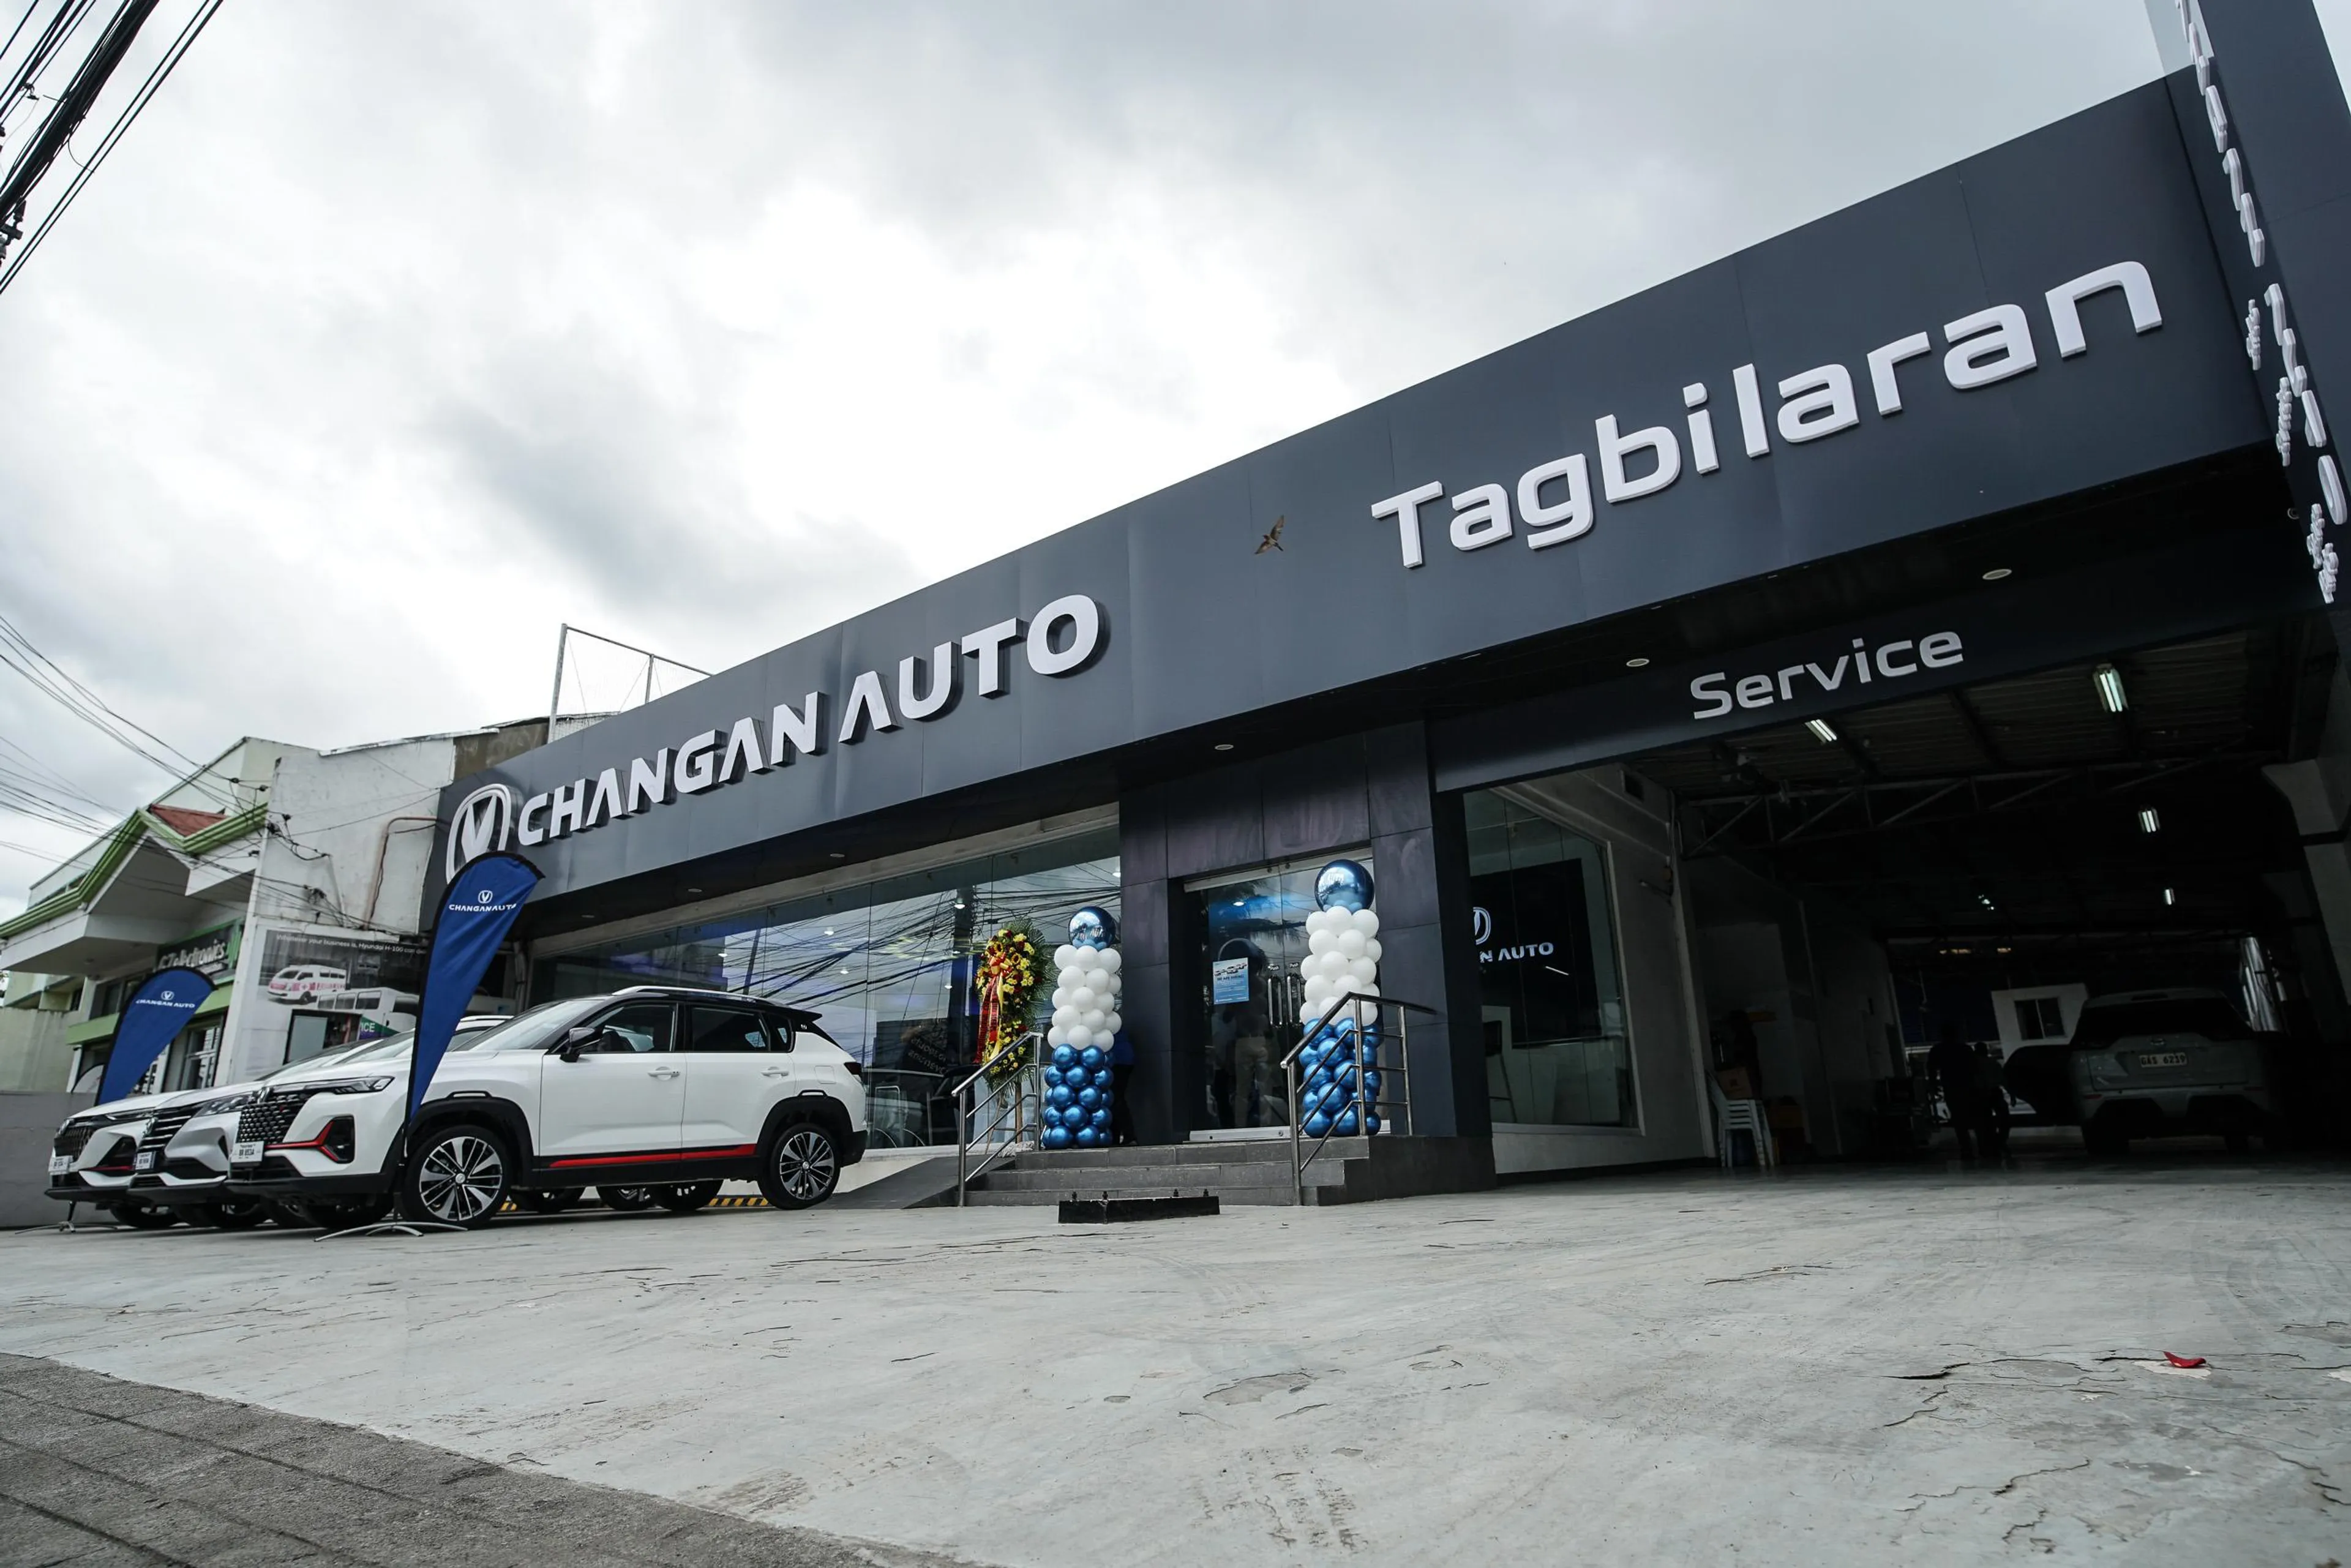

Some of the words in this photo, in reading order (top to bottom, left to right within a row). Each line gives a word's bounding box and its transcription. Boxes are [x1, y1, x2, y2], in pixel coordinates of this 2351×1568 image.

[1371, 260, 2162, 569] Tagbilaran
[518, 691, 819, 846] CHANGAN
[839, 594, 1100, 743] AUTO
[1690, 631, 1963, 719] Service
[1498, 942, 1554, 961] AUTO
